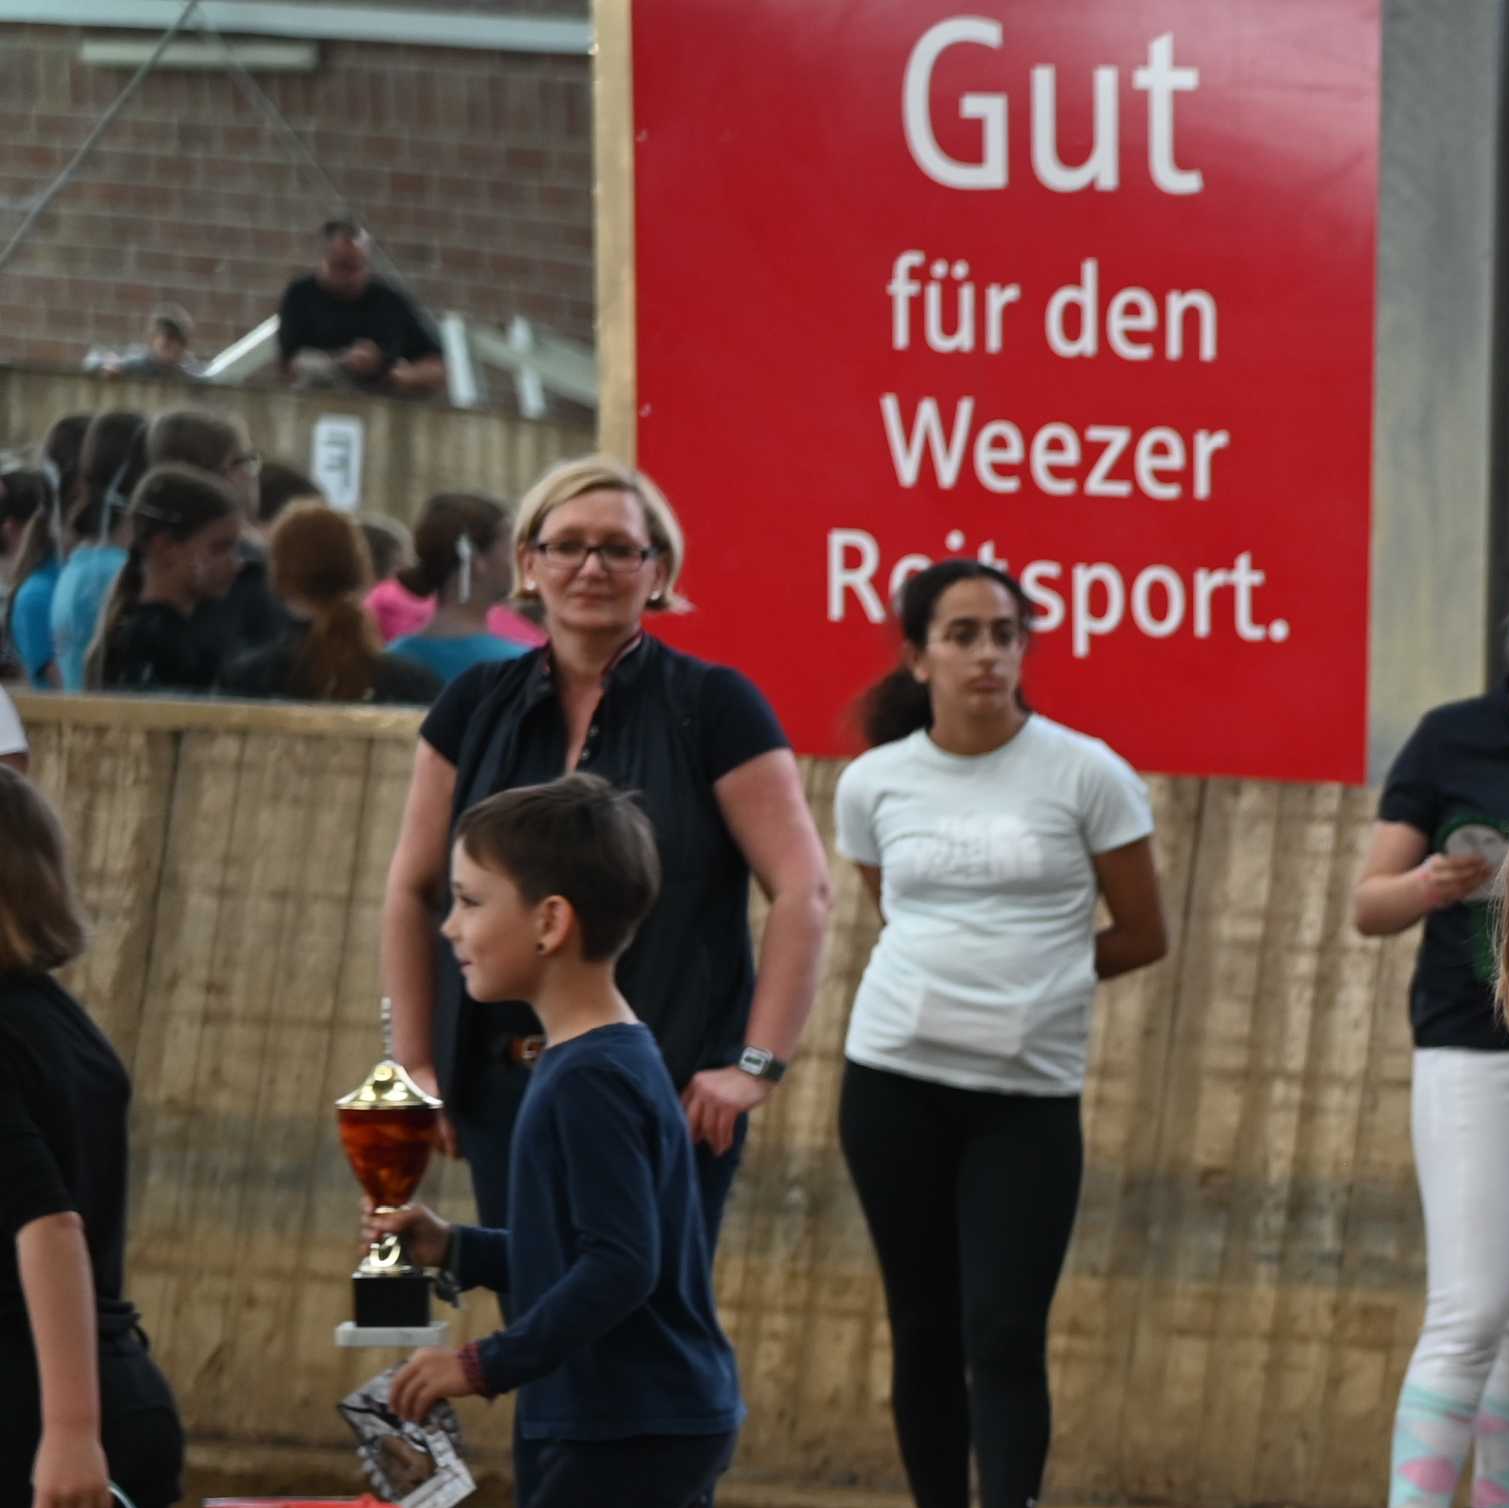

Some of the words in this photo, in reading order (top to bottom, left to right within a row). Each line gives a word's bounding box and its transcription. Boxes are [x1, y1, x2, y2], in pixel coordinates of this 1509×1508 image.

[904, 17, 1203, 194] Gut
[887, 249, 1021, 354] für
[1044, 258, 1218, 362] den
[880, 393, 1230, 500] Weezer
[827, 528, 1290, 659] Rsport.
